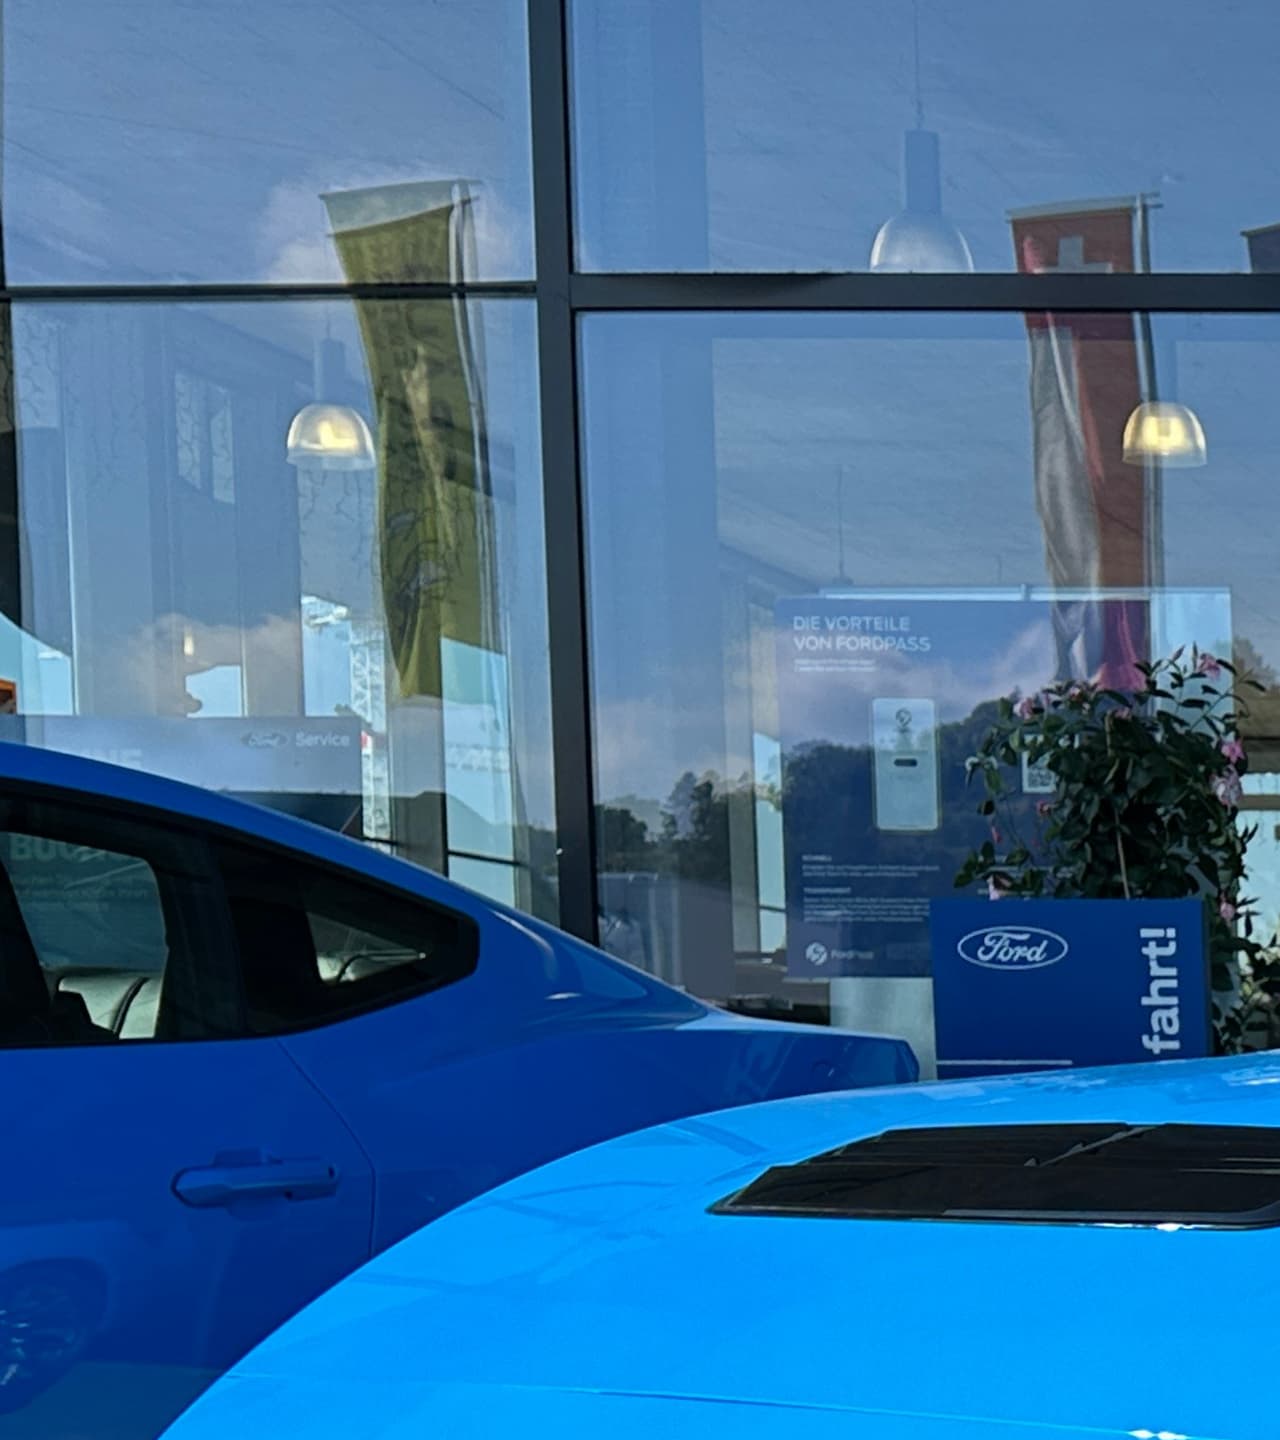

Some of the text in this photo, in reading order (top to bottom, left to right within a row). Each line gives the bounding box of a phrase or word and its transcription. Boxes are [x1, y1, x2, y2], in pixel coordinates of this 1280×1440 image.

[793, 615, 911, 632] DIE VORTEILE
[793, 635, 932, 652] VON FORDPASS
[294, 731, 351, 748] Service
